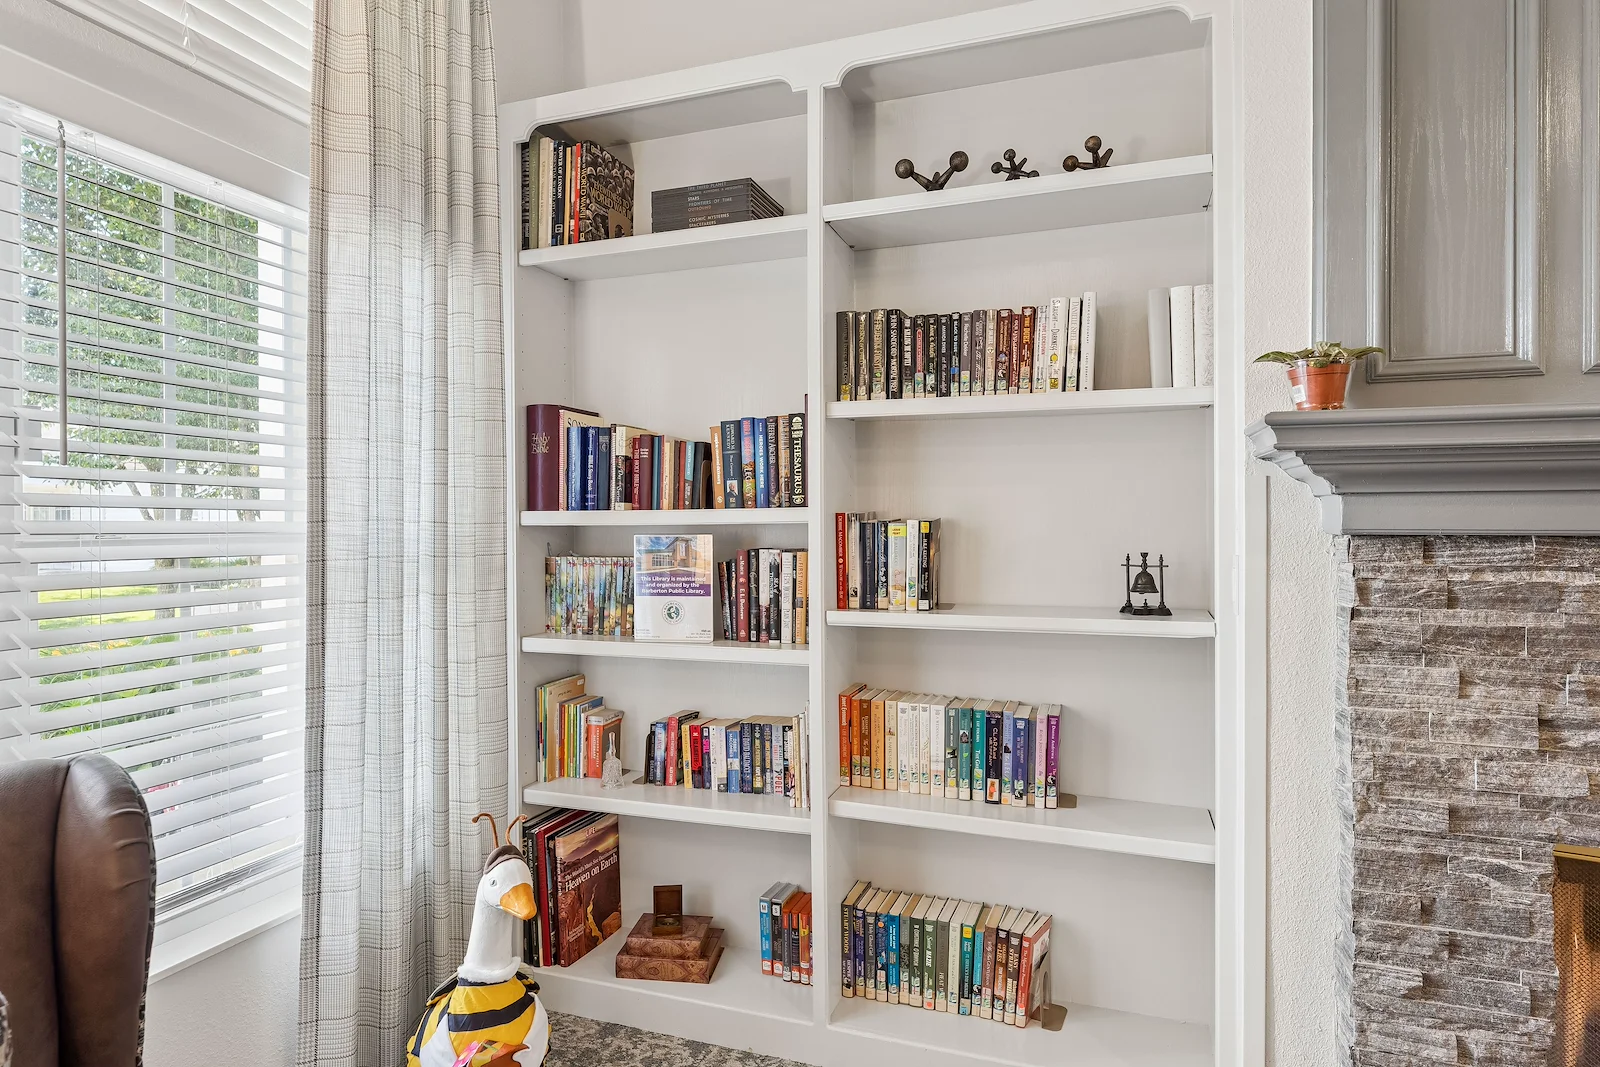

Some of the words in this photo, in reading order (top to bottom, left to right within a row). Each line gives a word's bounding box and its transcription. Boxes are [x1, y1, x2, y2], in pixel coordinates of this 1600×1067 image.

[1052, 300, 1060, 322] STRAIGHT
[1071, 301, 1079, 326] DANIELLE
[1050, 329, 1060, 351] DARKNESS
[1070, 326, 1078, 341] STEEL
[532, 432, 550, 446] Holy
[767, 422, 776, 442] JEFFREY
[532, 443, 550, 454] Bible
[794, 438, 802, 494] THESAURUS
[744, 468, 753, 498] LEGACY
[586, 827, 596, 838] LIFE
[565, 872, 590, 892] Heaven
[591, 866, 599, 877] on
[600, 854, 618, 871] Earth
